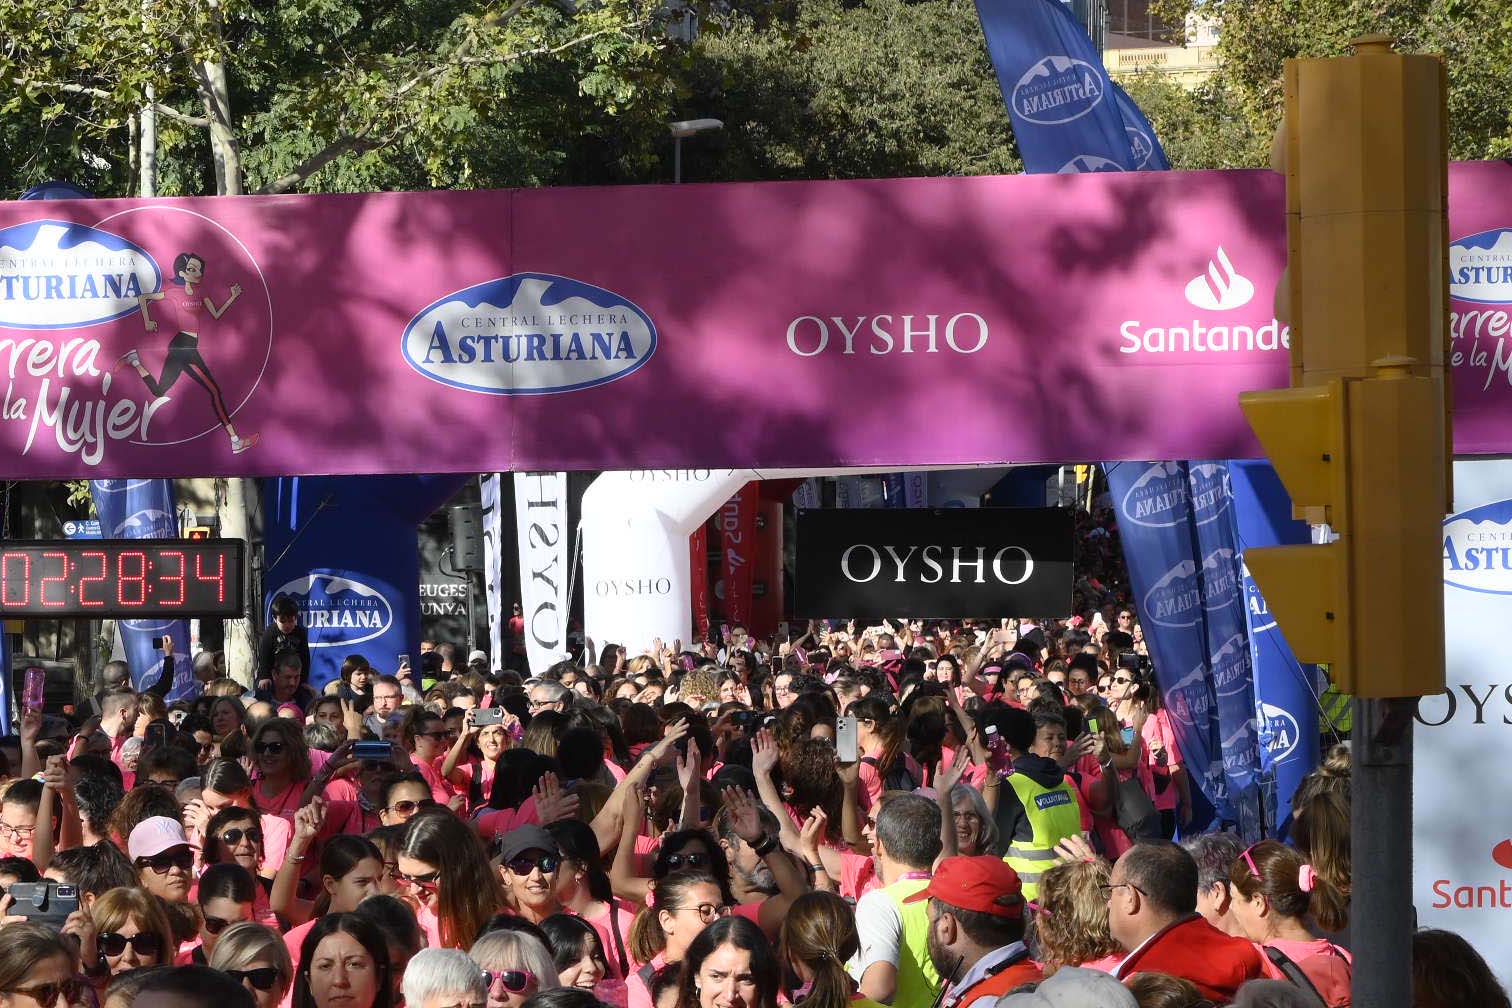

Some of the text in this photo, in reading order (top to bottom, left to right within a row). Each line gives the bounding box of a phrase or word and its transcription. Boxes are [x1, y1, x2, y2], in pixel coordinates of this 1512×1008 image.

[422, 320, 638, 364] ASTURIANA
[462, 313, 628, 328] CENTRAL LECHERA
[786, 312, 989, 357] OYSHO
[3, 379, 28, 420] la
[23, 371, 172, 466] Mujer
[2, 552, 224, 606] 02:28:34
[841, 543, 1035, 585] OYSHO
[595, 576, 671, 598] OYSHO
[302, 609, 383, 628] URIANA
